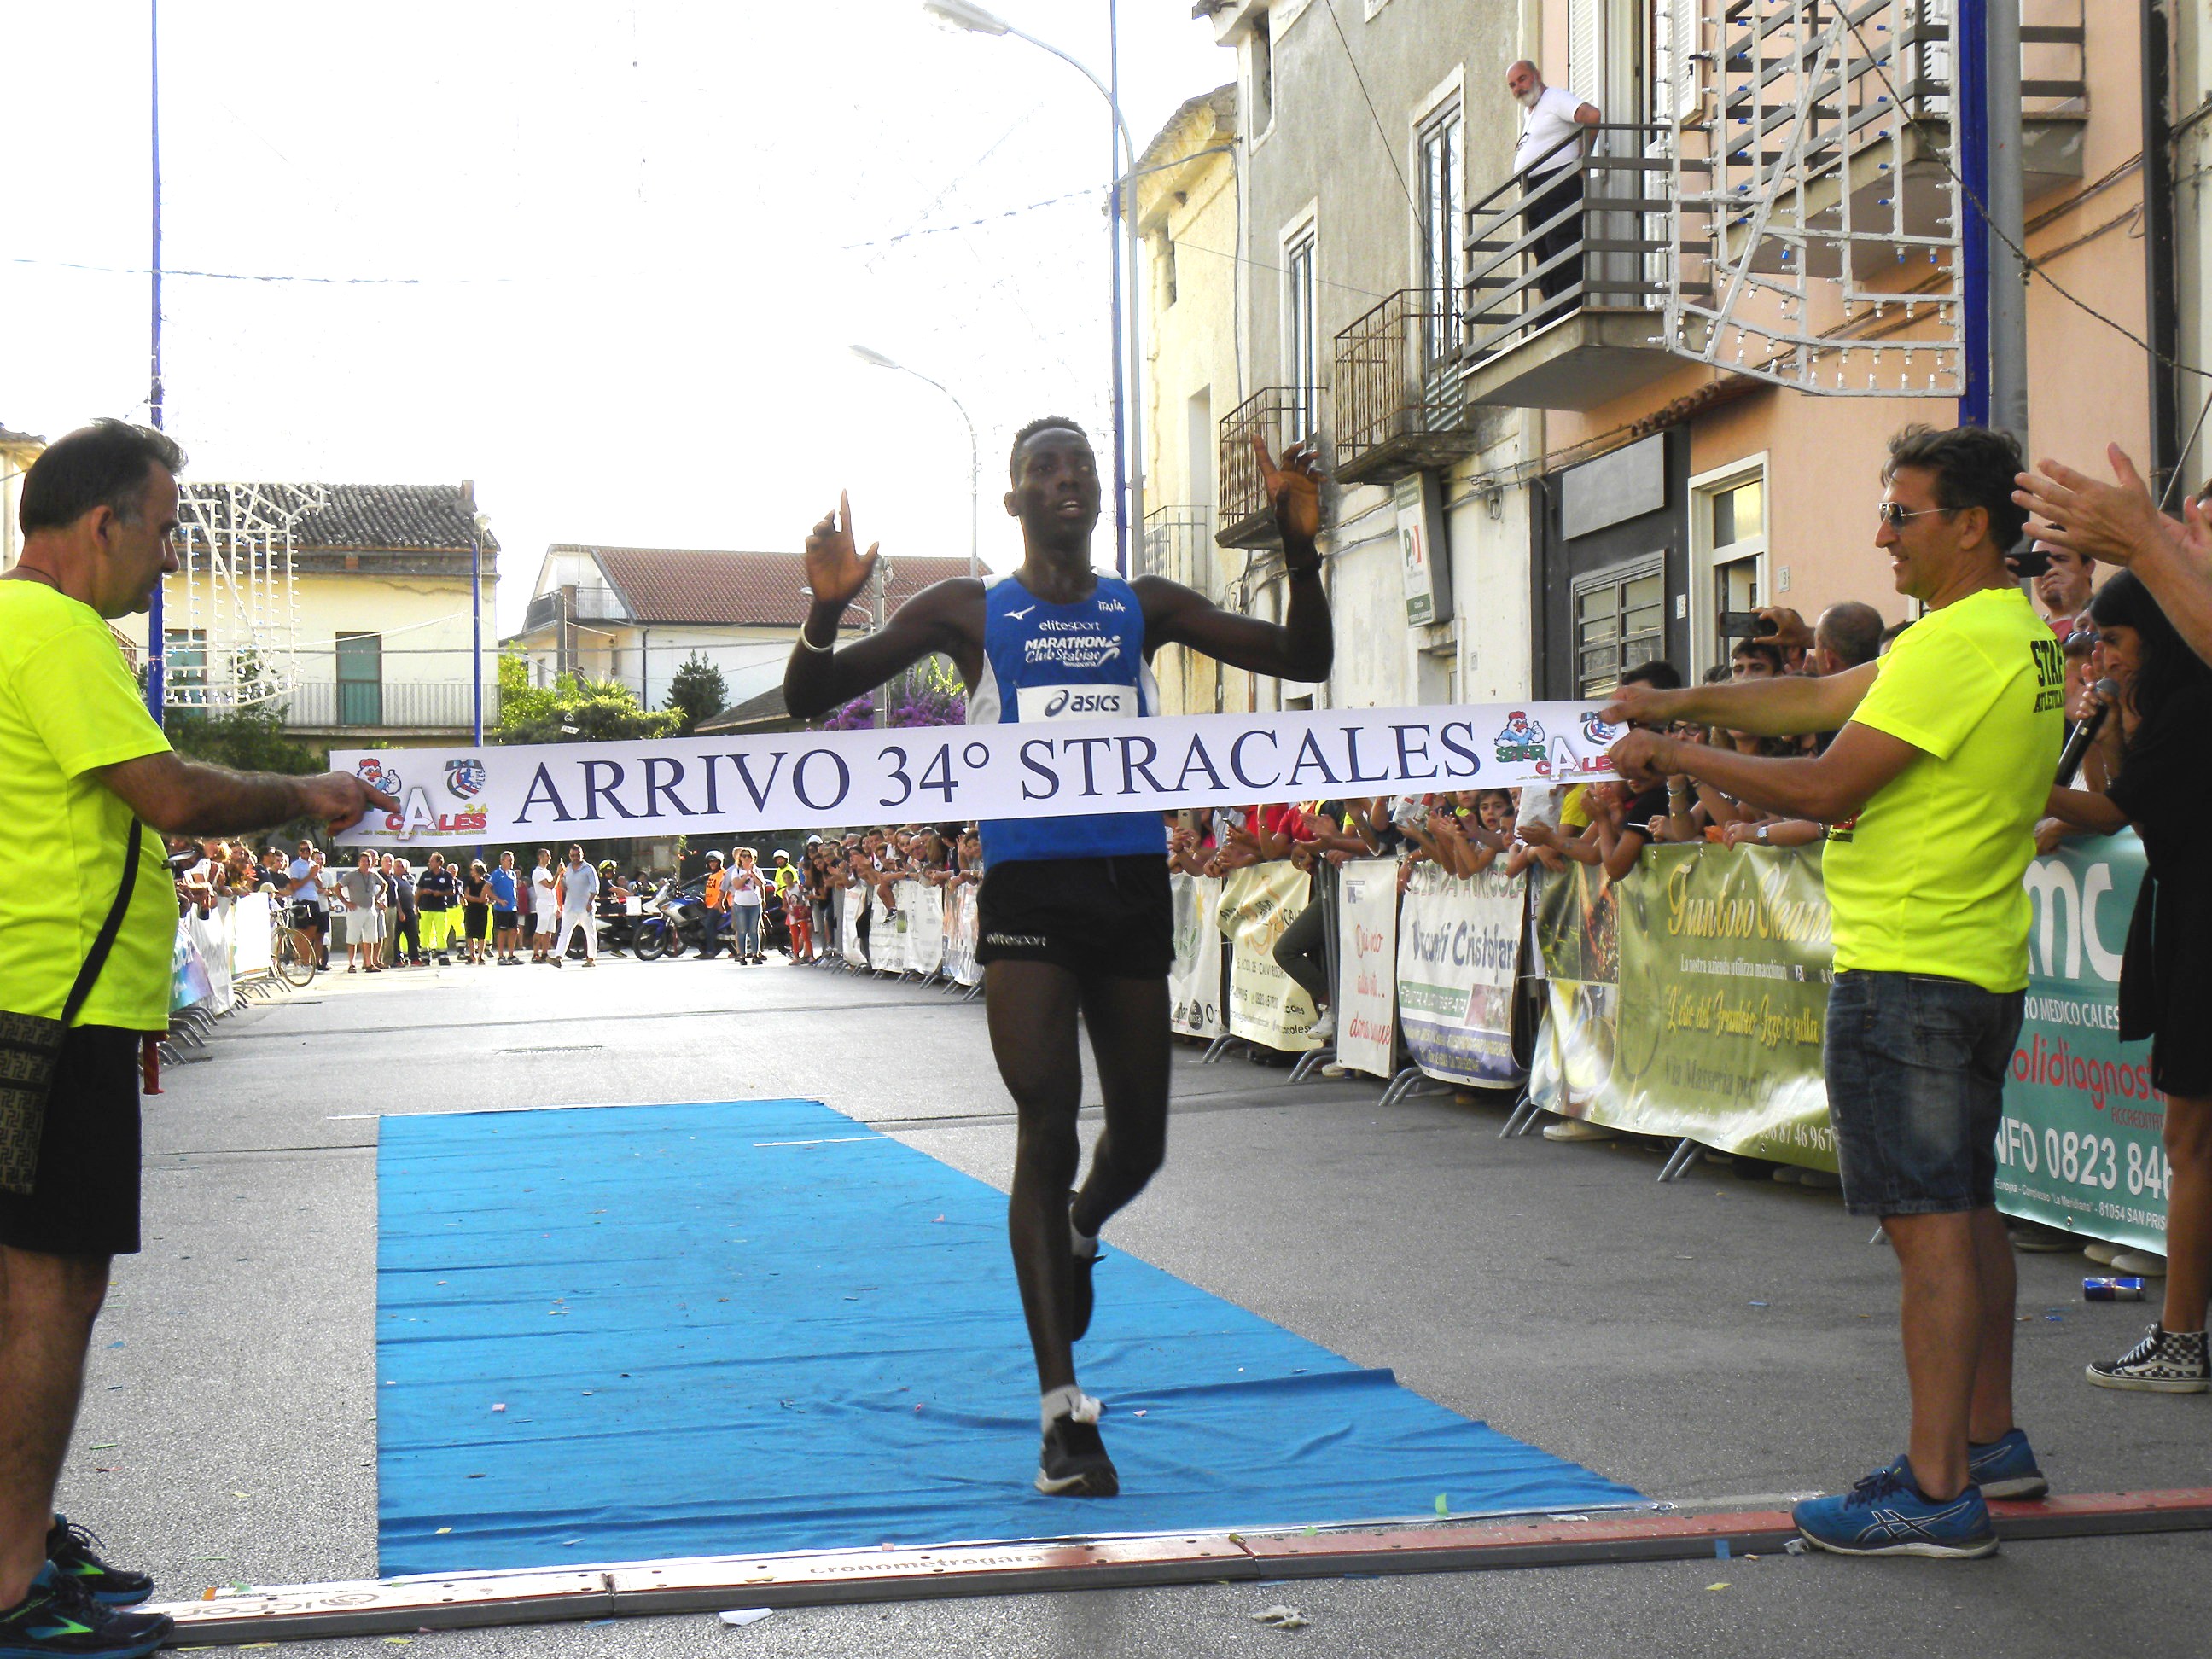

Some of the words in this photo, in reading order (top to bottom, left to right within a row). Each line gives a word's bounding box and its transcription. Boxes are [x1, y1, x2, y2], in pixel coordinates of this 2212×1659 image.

[1039, 620, 1101, 631] elitesport
[1025, 637, 1107, 651] MARATHON
[1026, 649, 1055, 663] Club
[1071, 694, 1120, 713] asics
[512, 748, 850, 824] ARRIVO
[877, 742, 990, 807] 34°
[1020, 720, 1481, 800] STRACALES
[2040, 998, 2080, 1026] MEDICO
[2045, 1128, 2117, 1190] 0823
[2099, 1202, 2125, 1220] 81054
[2127, 1207, 2145, 1225] SAN
[810, 1553, 1044, 1575] cronometrogara
